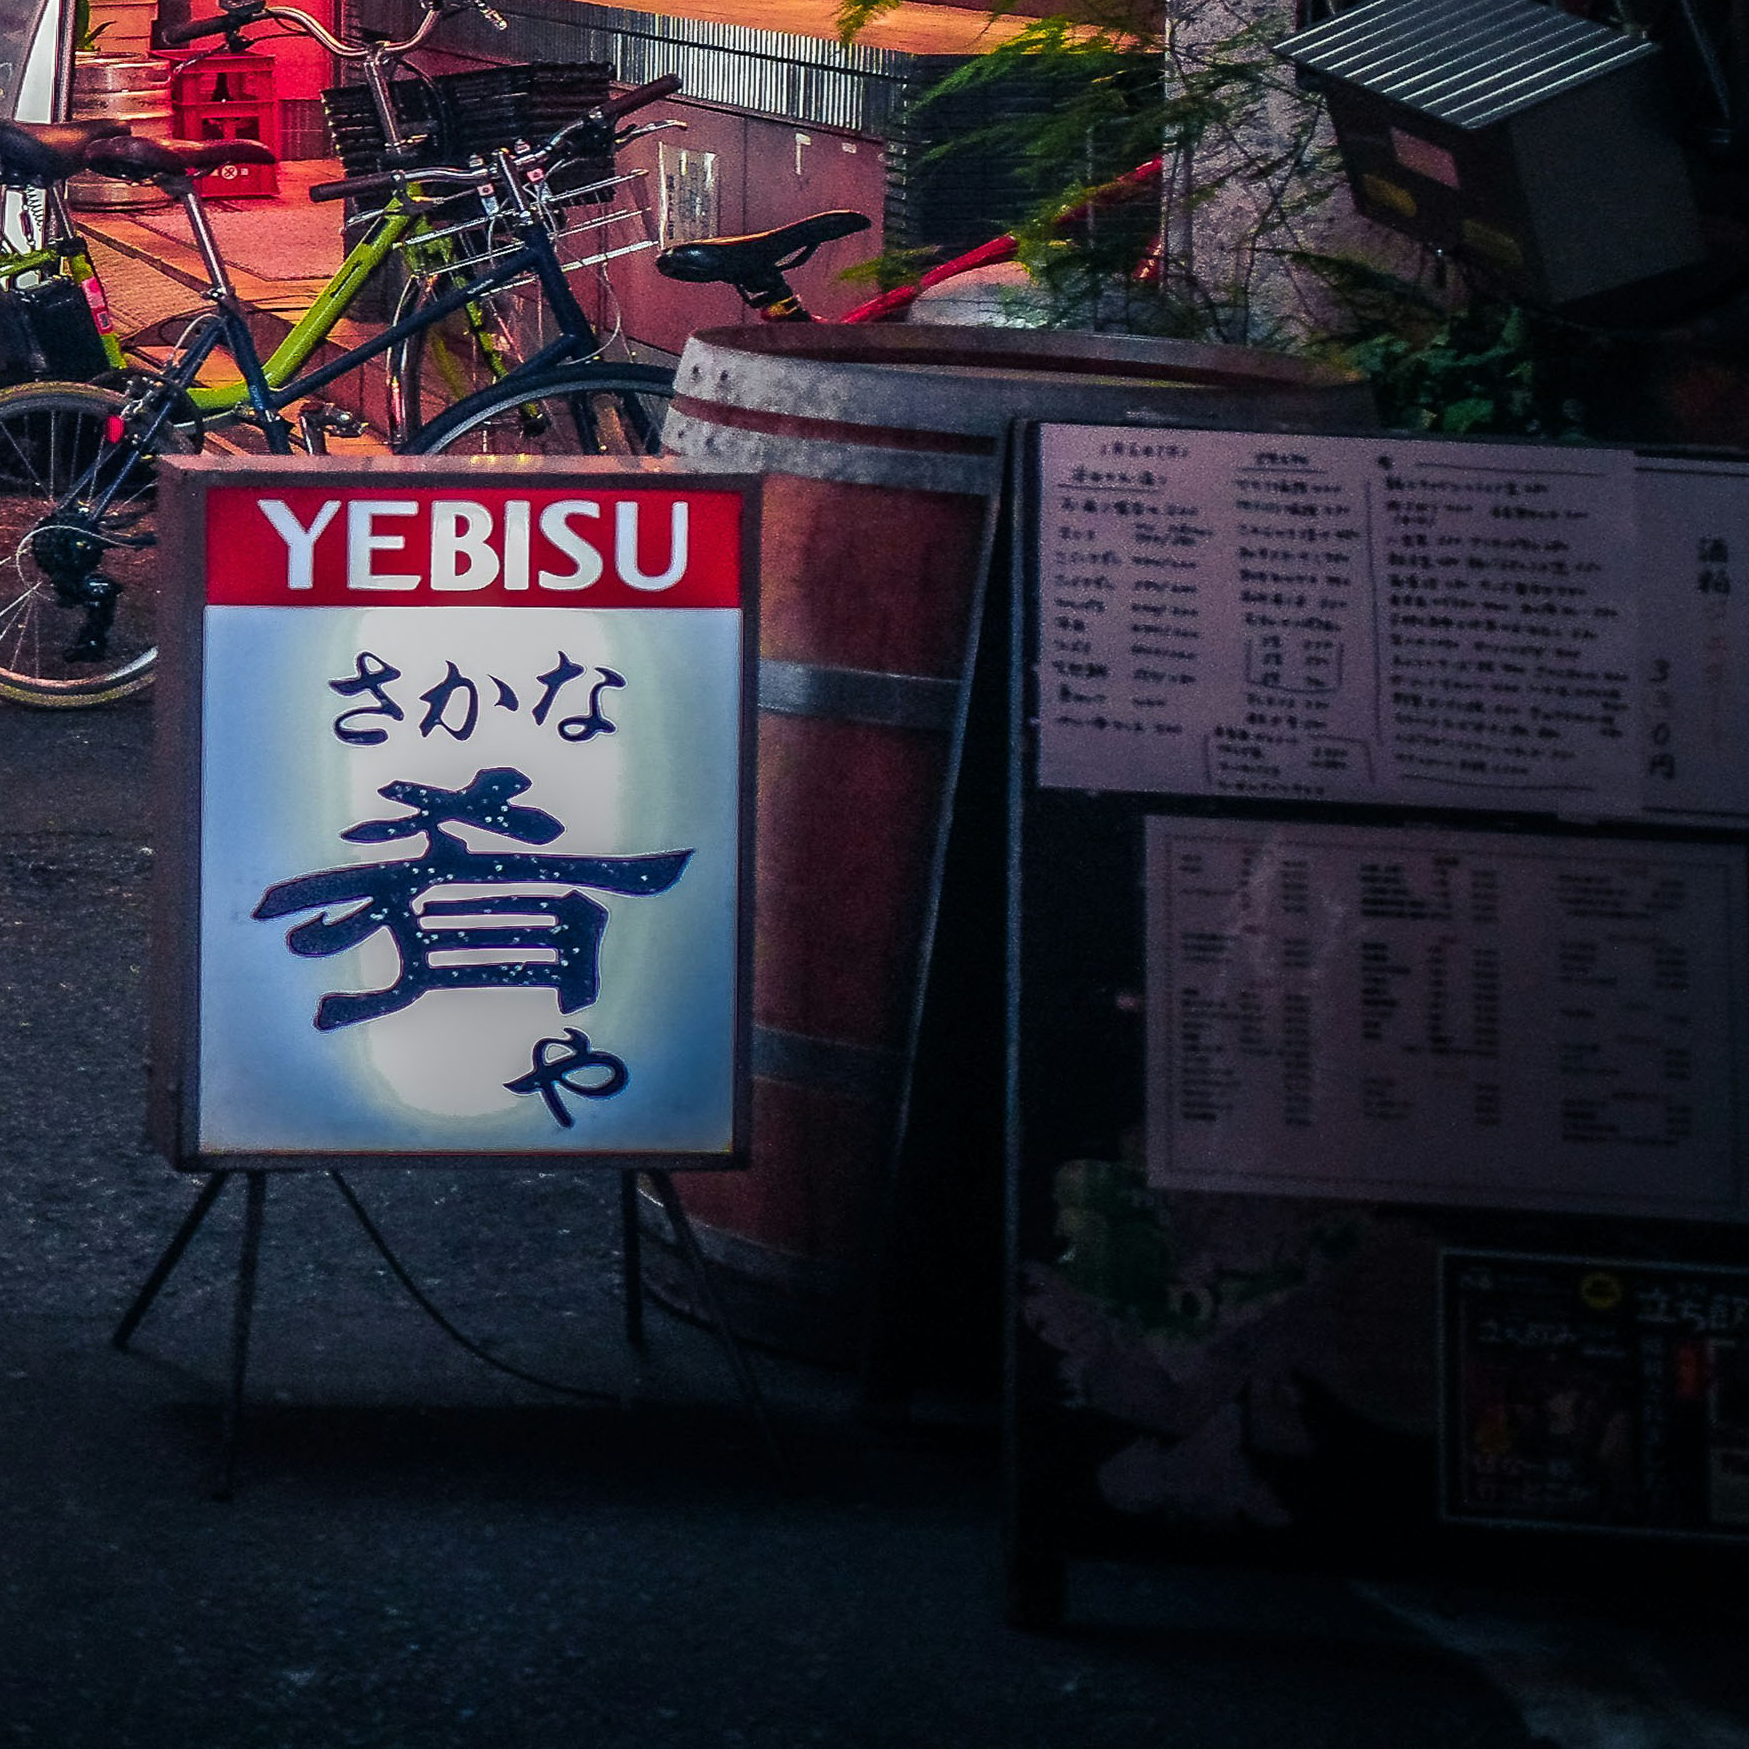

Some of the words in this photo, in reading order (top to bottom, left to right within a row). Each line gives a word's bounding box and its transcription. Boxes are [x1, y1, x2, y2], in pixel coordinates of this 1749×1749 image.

[257, 499, 689, 592] YEBISU
[329, 651, 627, 746] さかな
[254, 767, 695, 1032] 肴
[504, 1026, 630, 1129] や
